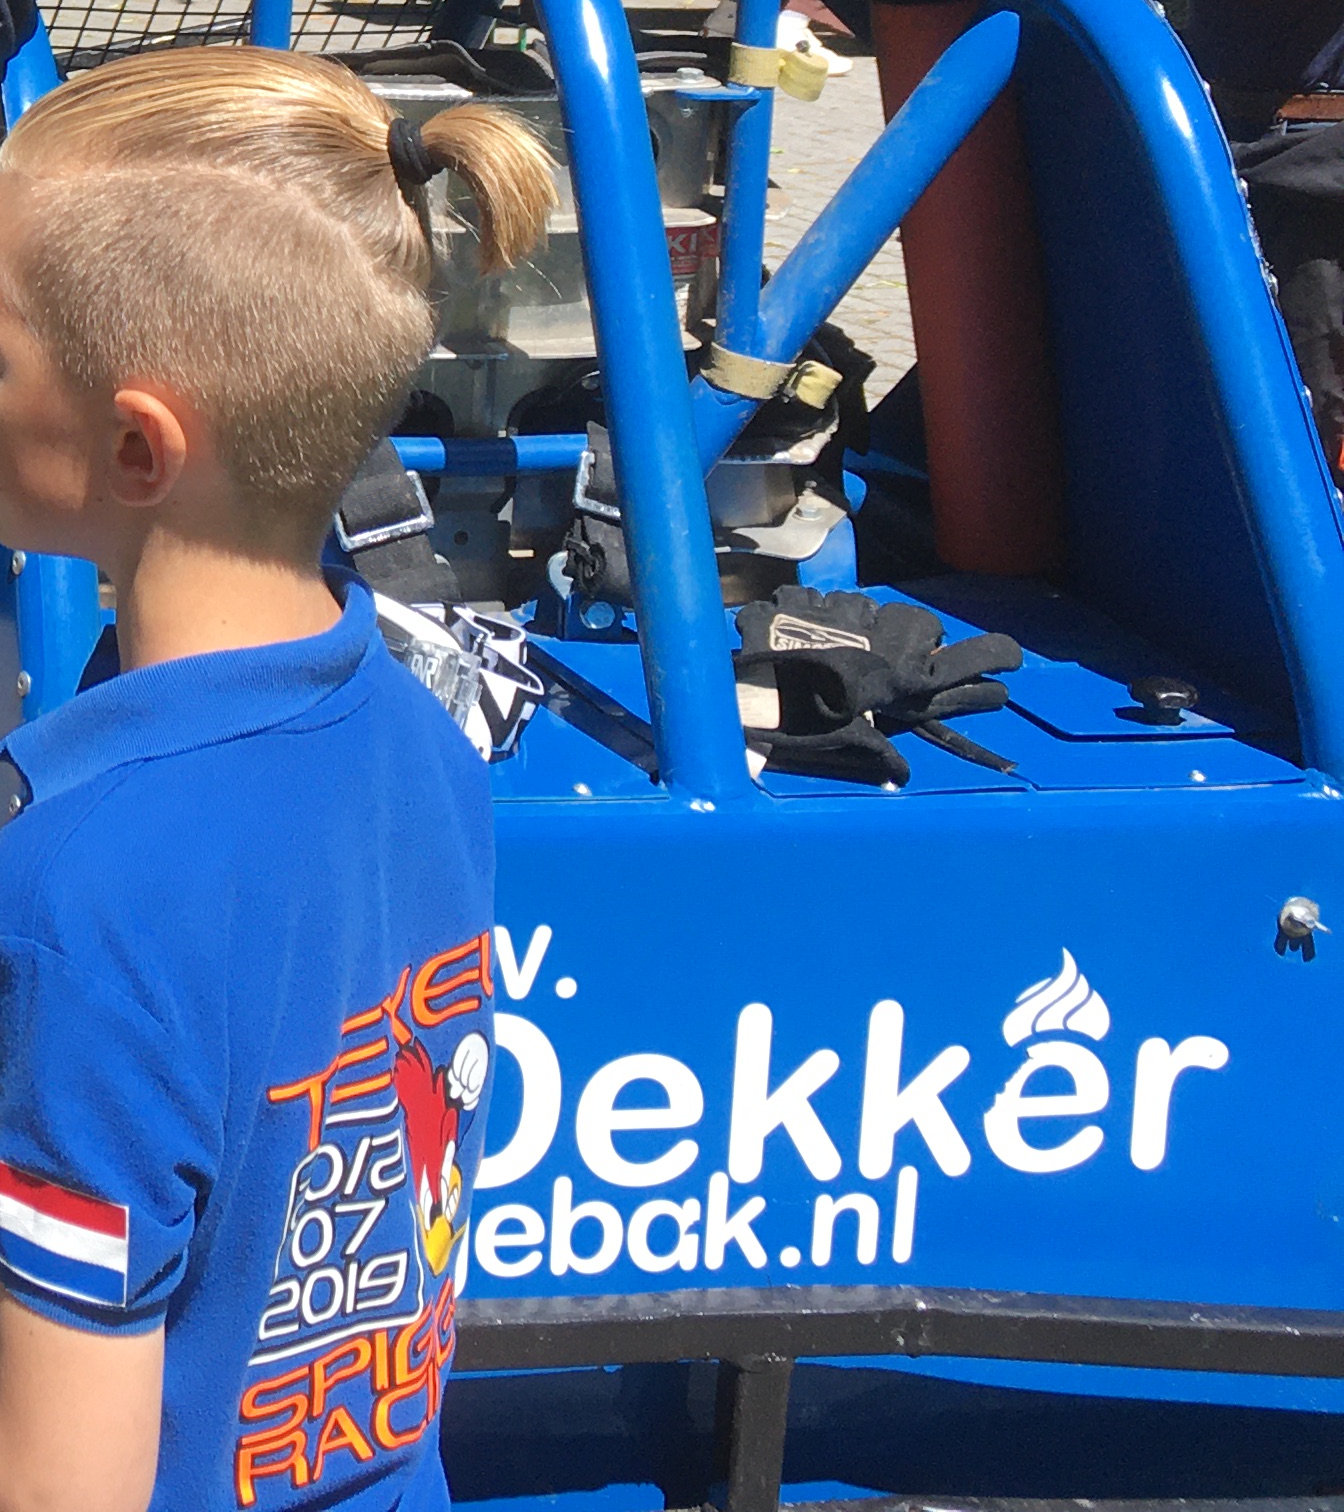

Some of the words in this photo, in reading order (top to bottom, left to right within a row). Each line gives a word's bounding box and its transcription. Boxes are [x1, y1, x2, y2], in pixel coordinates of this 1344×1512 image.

[474, 999, 1230, 1189] Dekker
[291, 1197, 389, 1269] 07
[456, 1165, 919, 1299] ebak.nl
[257, 1250, 409, 1341] 2019
